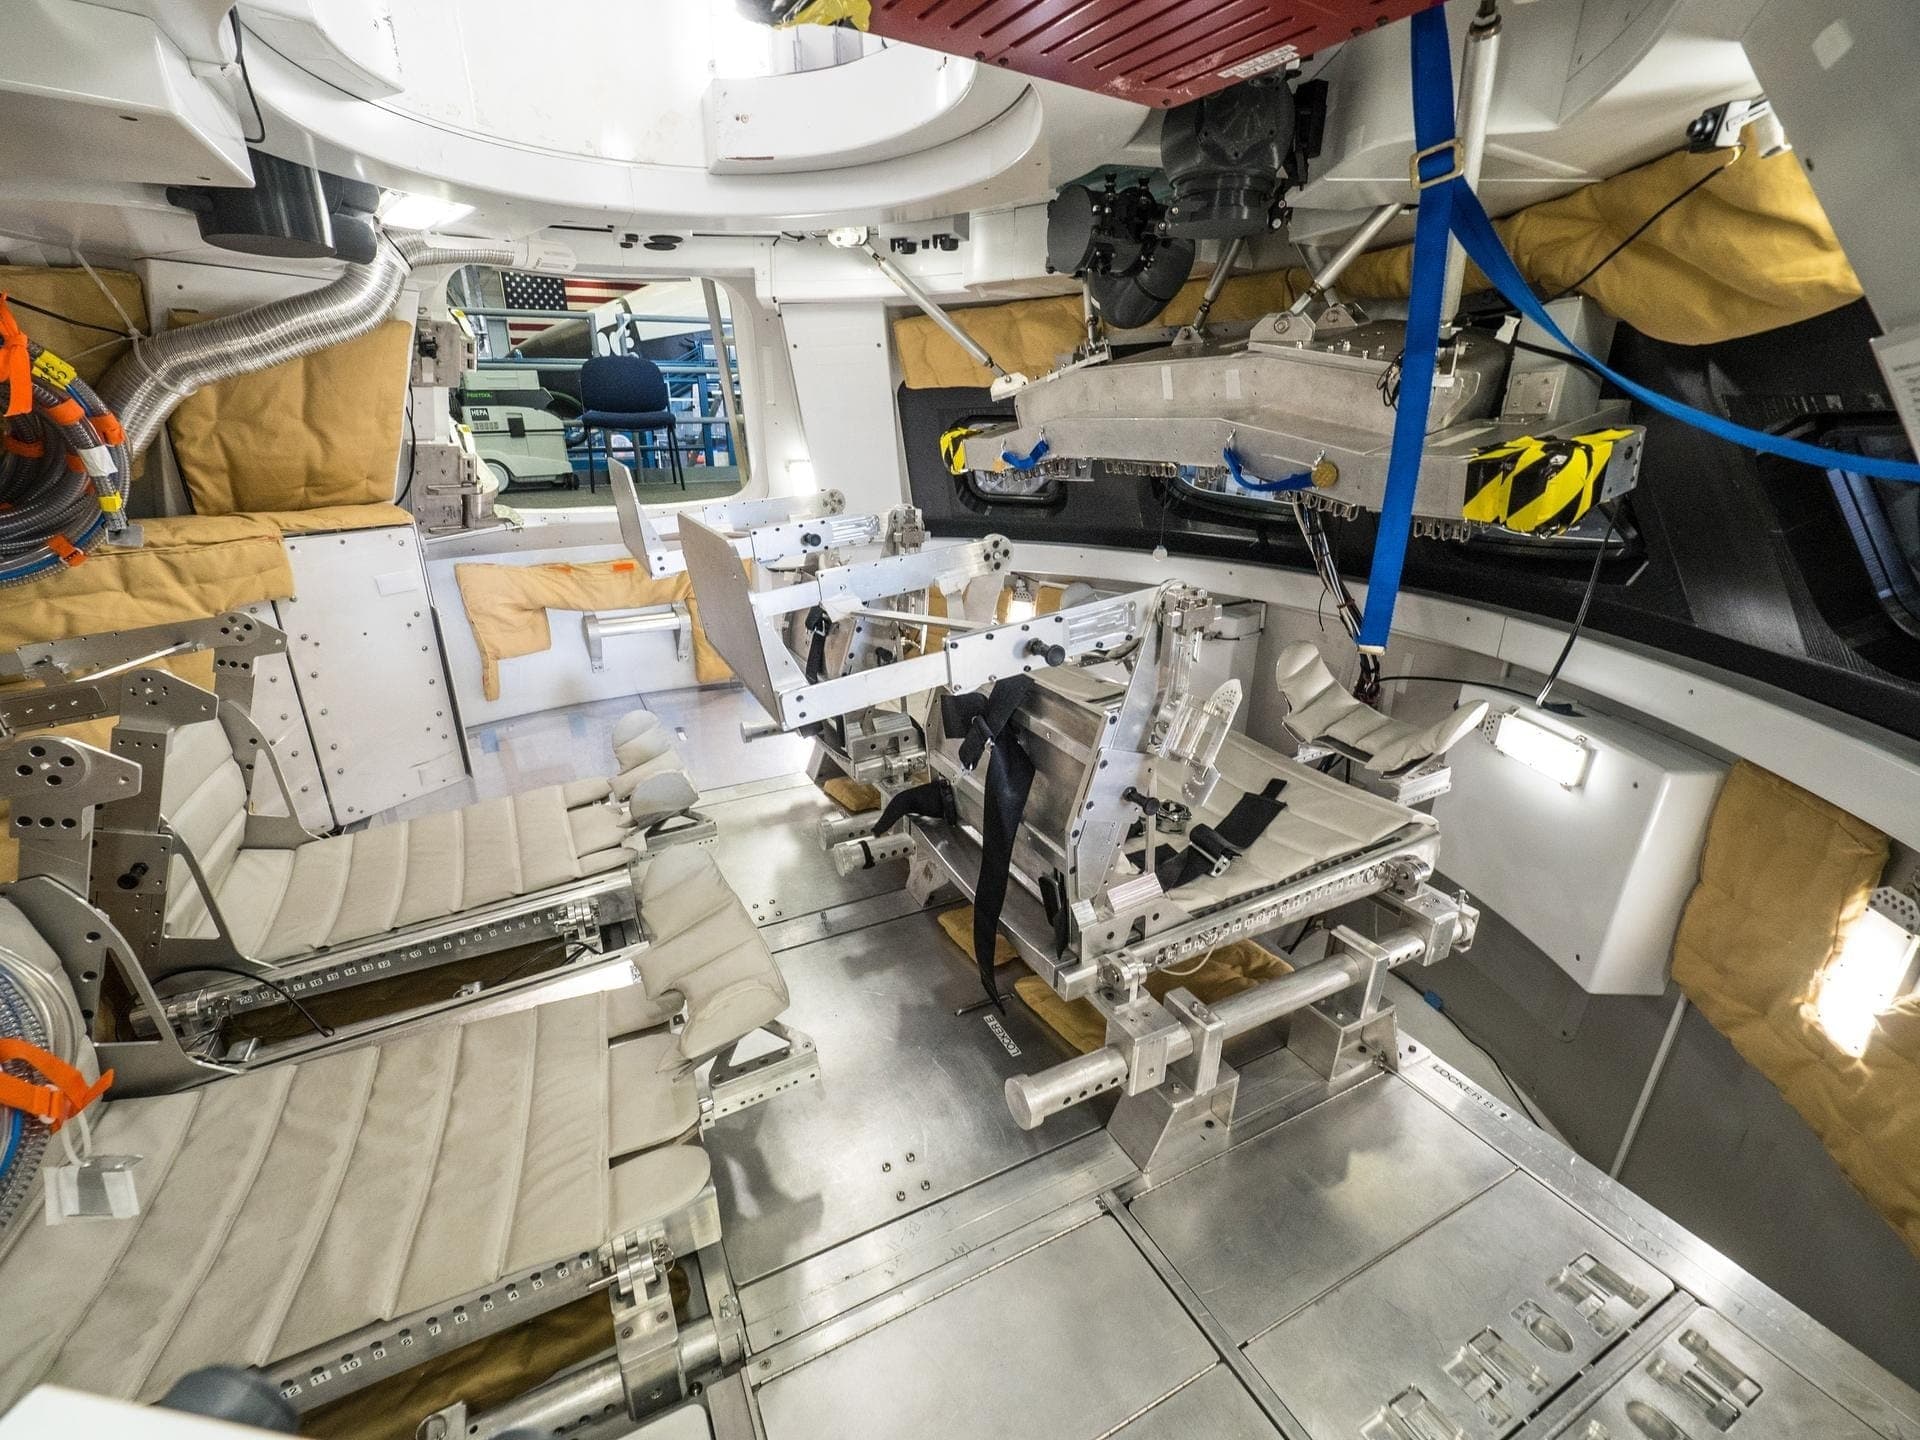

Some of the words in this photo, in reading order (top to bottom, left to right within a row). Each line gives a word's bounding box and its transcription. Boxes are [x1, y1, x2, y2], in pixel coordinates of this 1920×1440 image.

[471, 409, 488, 417] HEPA
[985, 1015, 994, 1023] E
[992, 1024, 1019, 1055] LOCKER
[1432, 1064, 1483, 1100] LOCKER
[281, 1386, 298, 1399] 12
[313, 1373, 328, 1384] 11
[343, 1360, 359, 1372] 10
[374, 1350, 384, 1359] 9
[402, 1337, 412, 1346] 8
